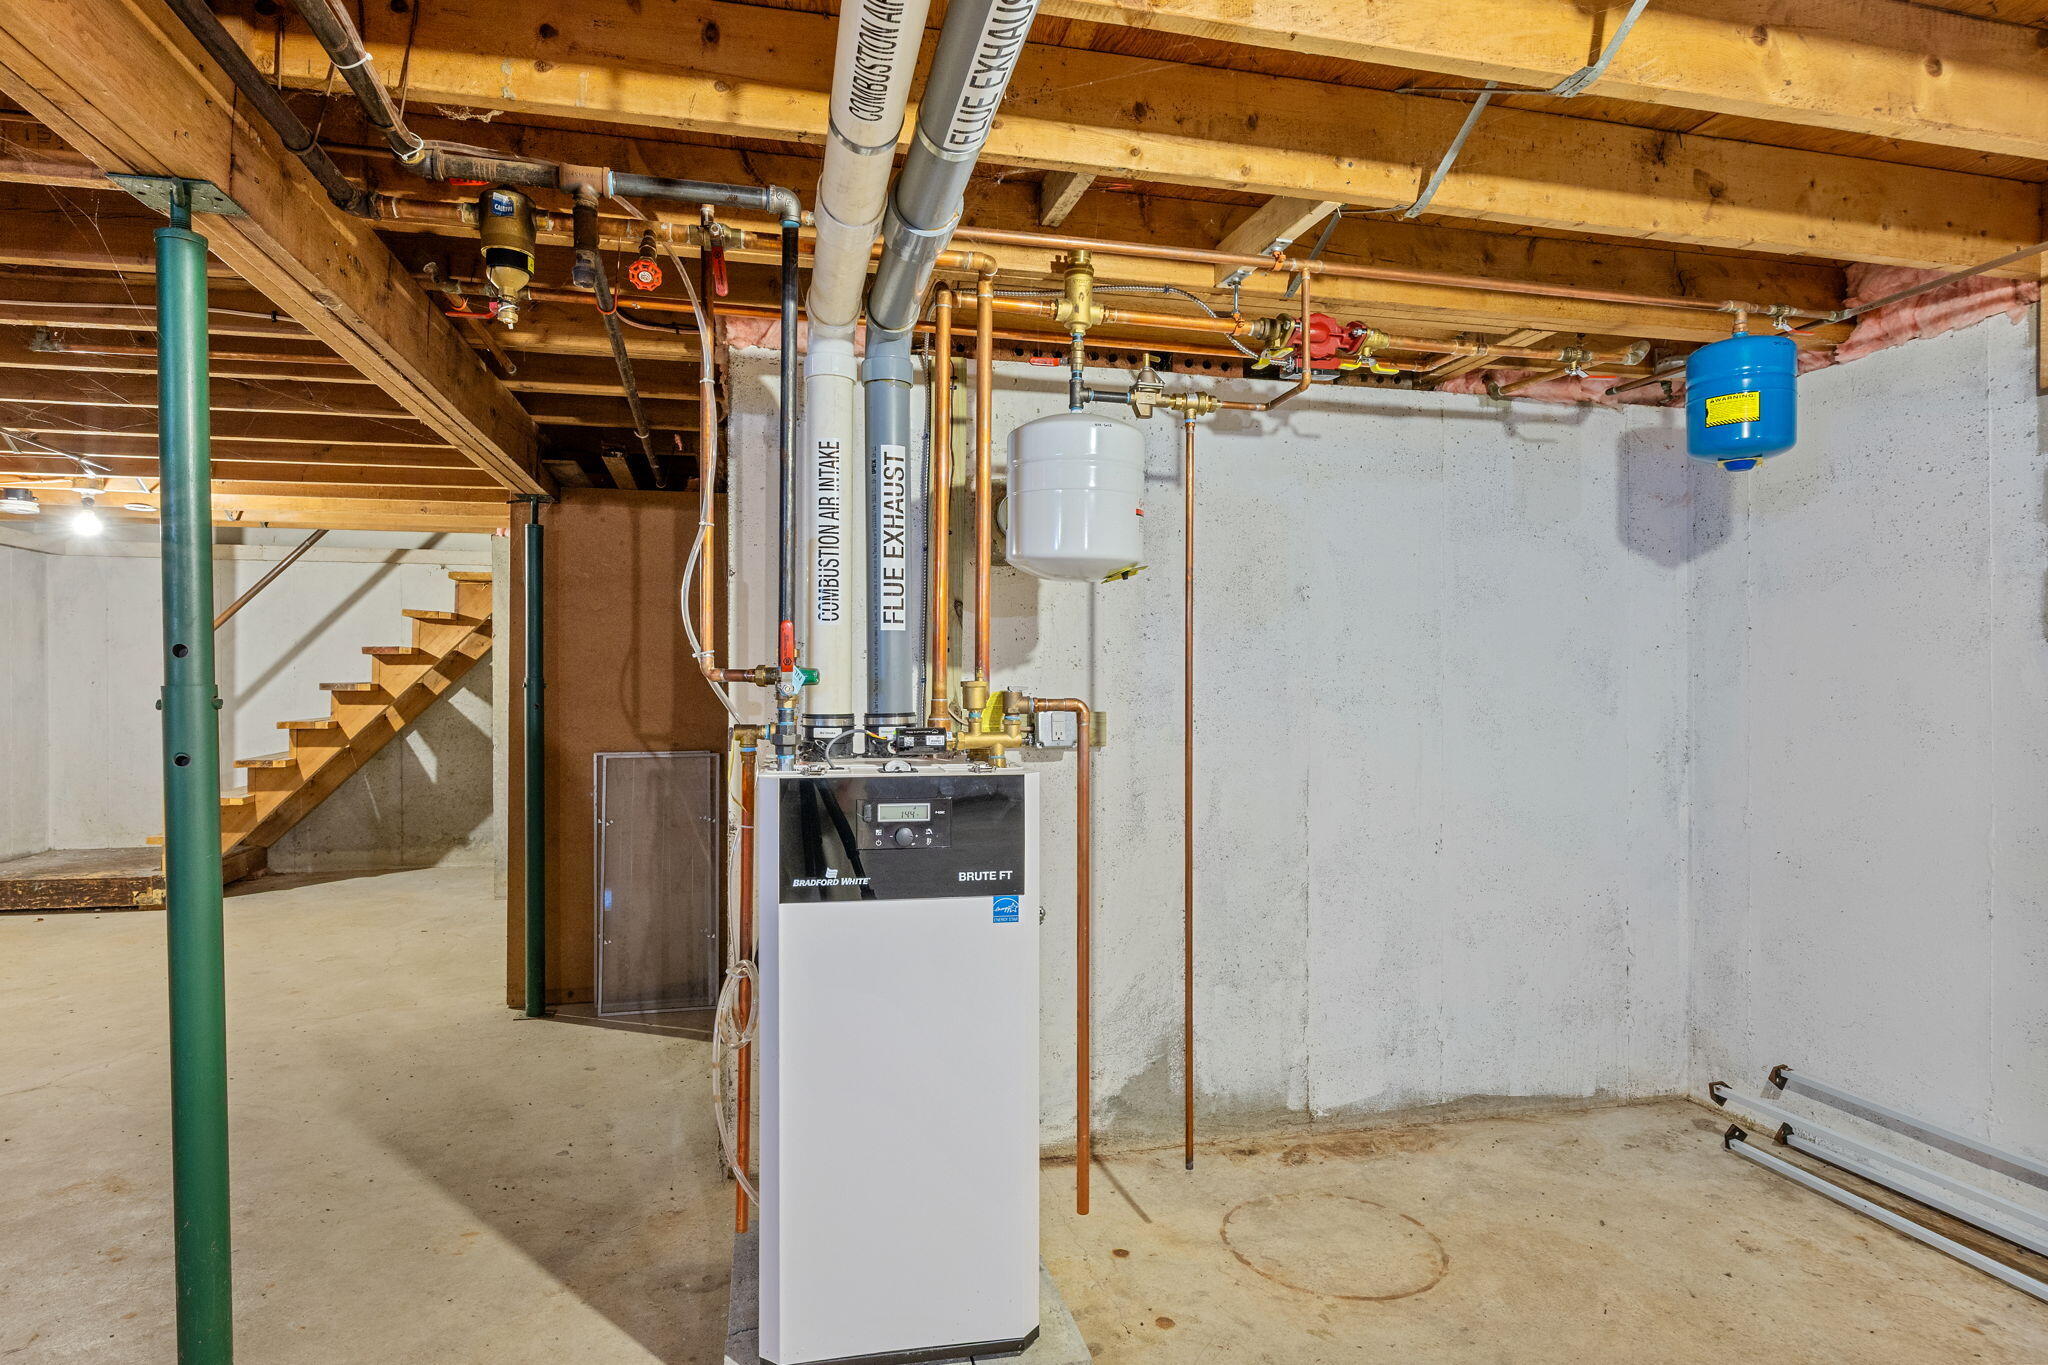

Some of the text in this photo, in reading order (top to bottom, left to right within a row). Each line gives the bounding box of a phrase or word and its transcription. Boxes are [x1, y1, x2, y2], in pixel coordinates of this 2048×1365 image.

[849, 17, 900, 122] COMBUSTION
[949, 93, 998, 146] FLUE
[818, 441, 840, 622] COMBUSTION AIR INTAKE
[883, 451, 905, 624] FLUE EXHAUST
[793, 877, 870, 887] BRADFORD WHITE
[958, 870, 1013, 882] BRUTE FT
